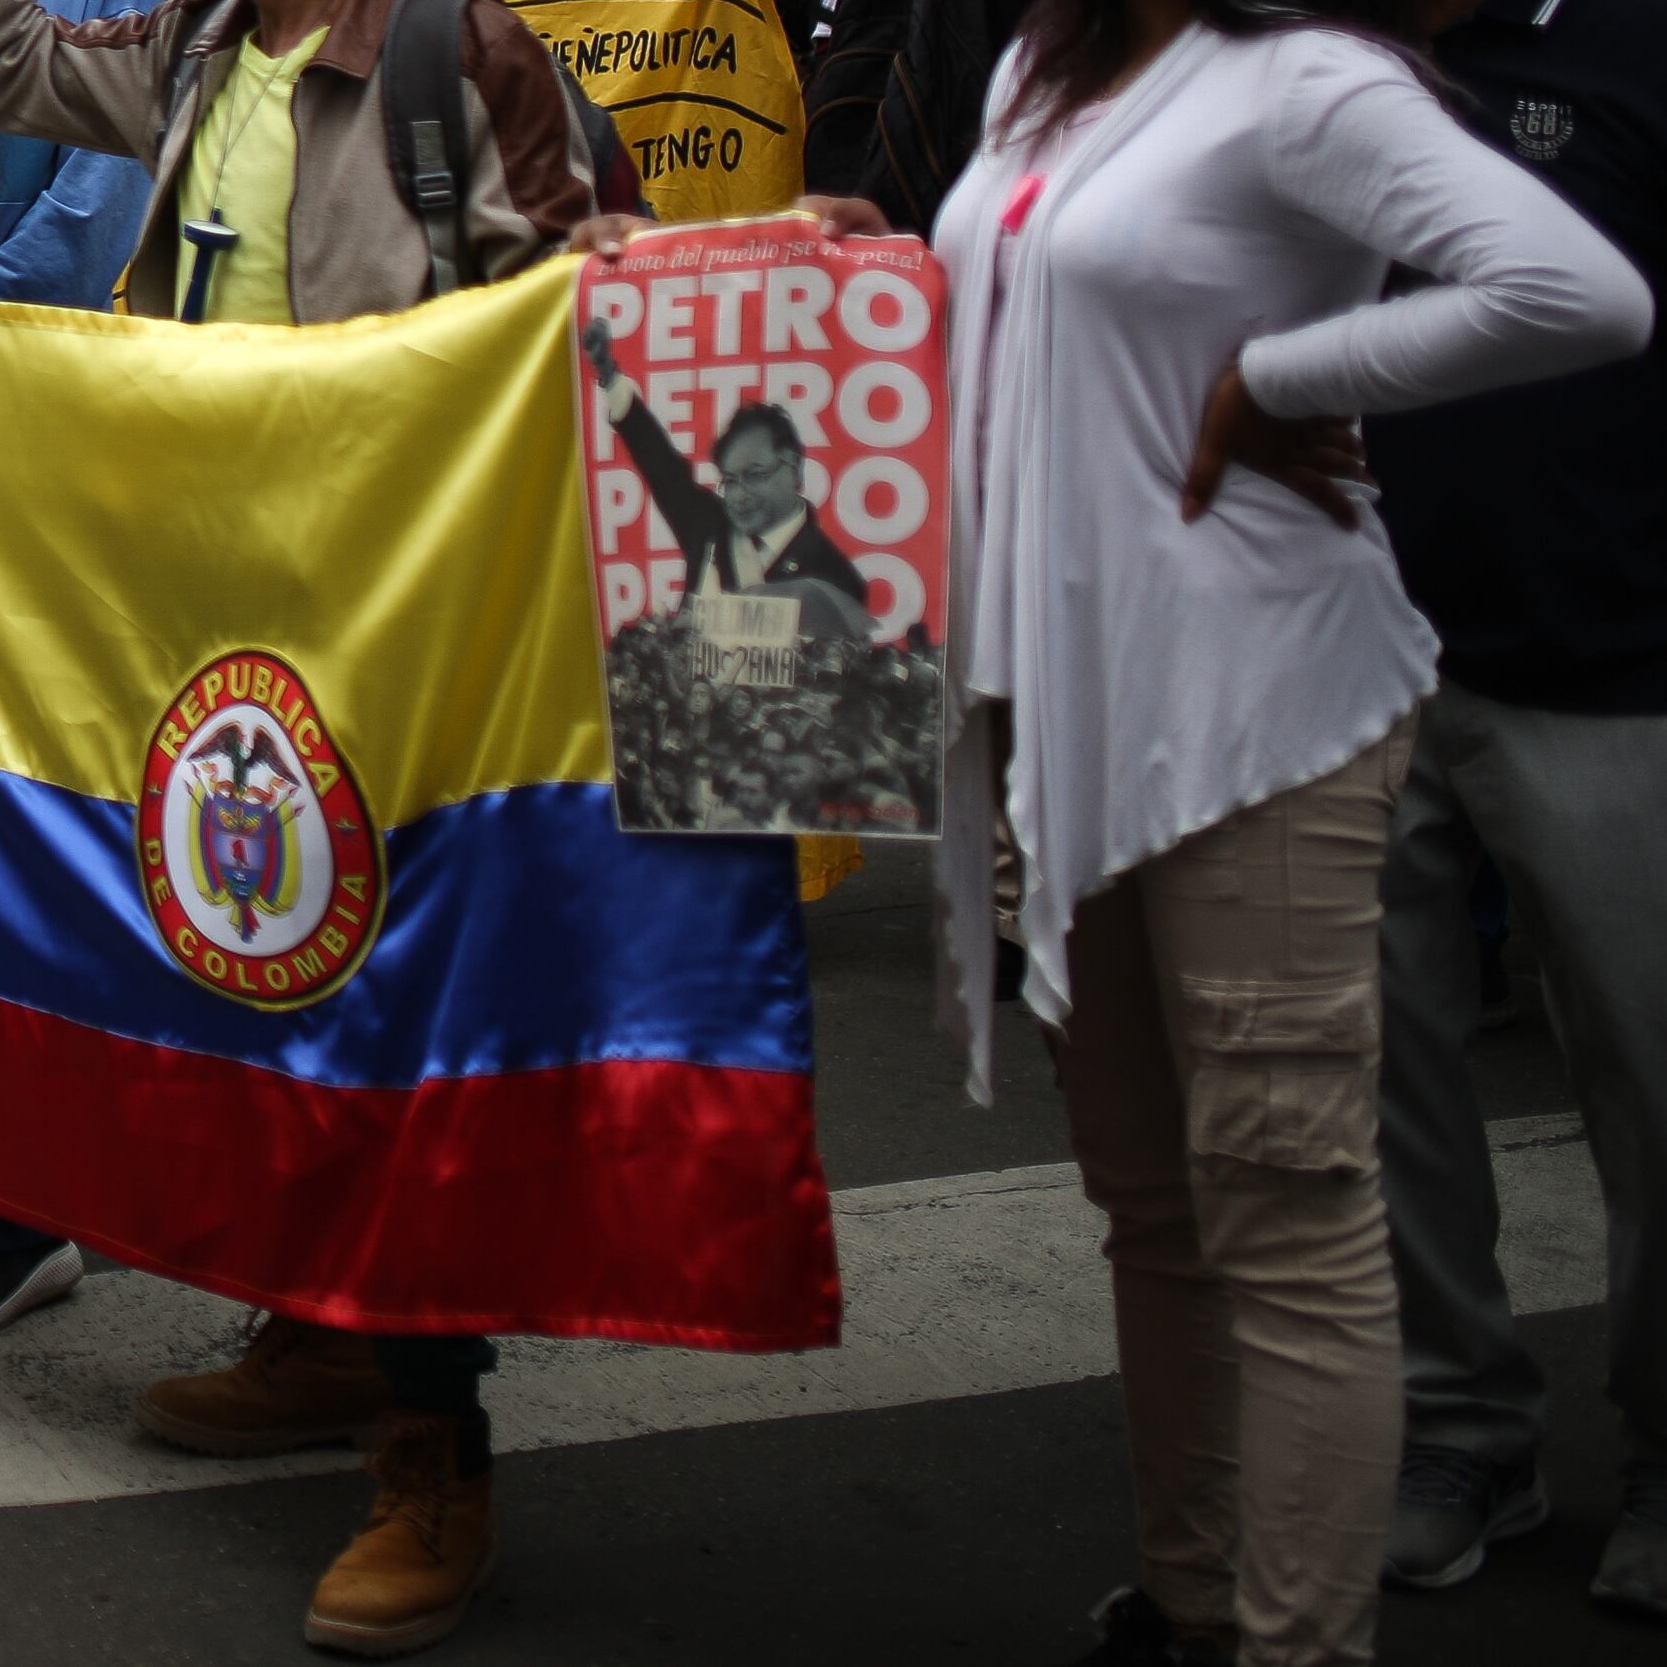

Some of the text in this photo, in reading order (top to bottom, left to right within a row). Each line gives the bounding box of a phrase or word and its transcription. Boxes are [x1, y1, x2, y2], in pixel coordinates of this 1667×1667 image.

[632, 125, 743, 181] TENGO
[670, 244, 703, 270] del
[706, 238, 780, 272] pueblo
[590, 265, 932, 362] PETRO
[156, 662, 341, 798] REPUBLICA
[145, 839, 369, 992] DE COLOMBIA
